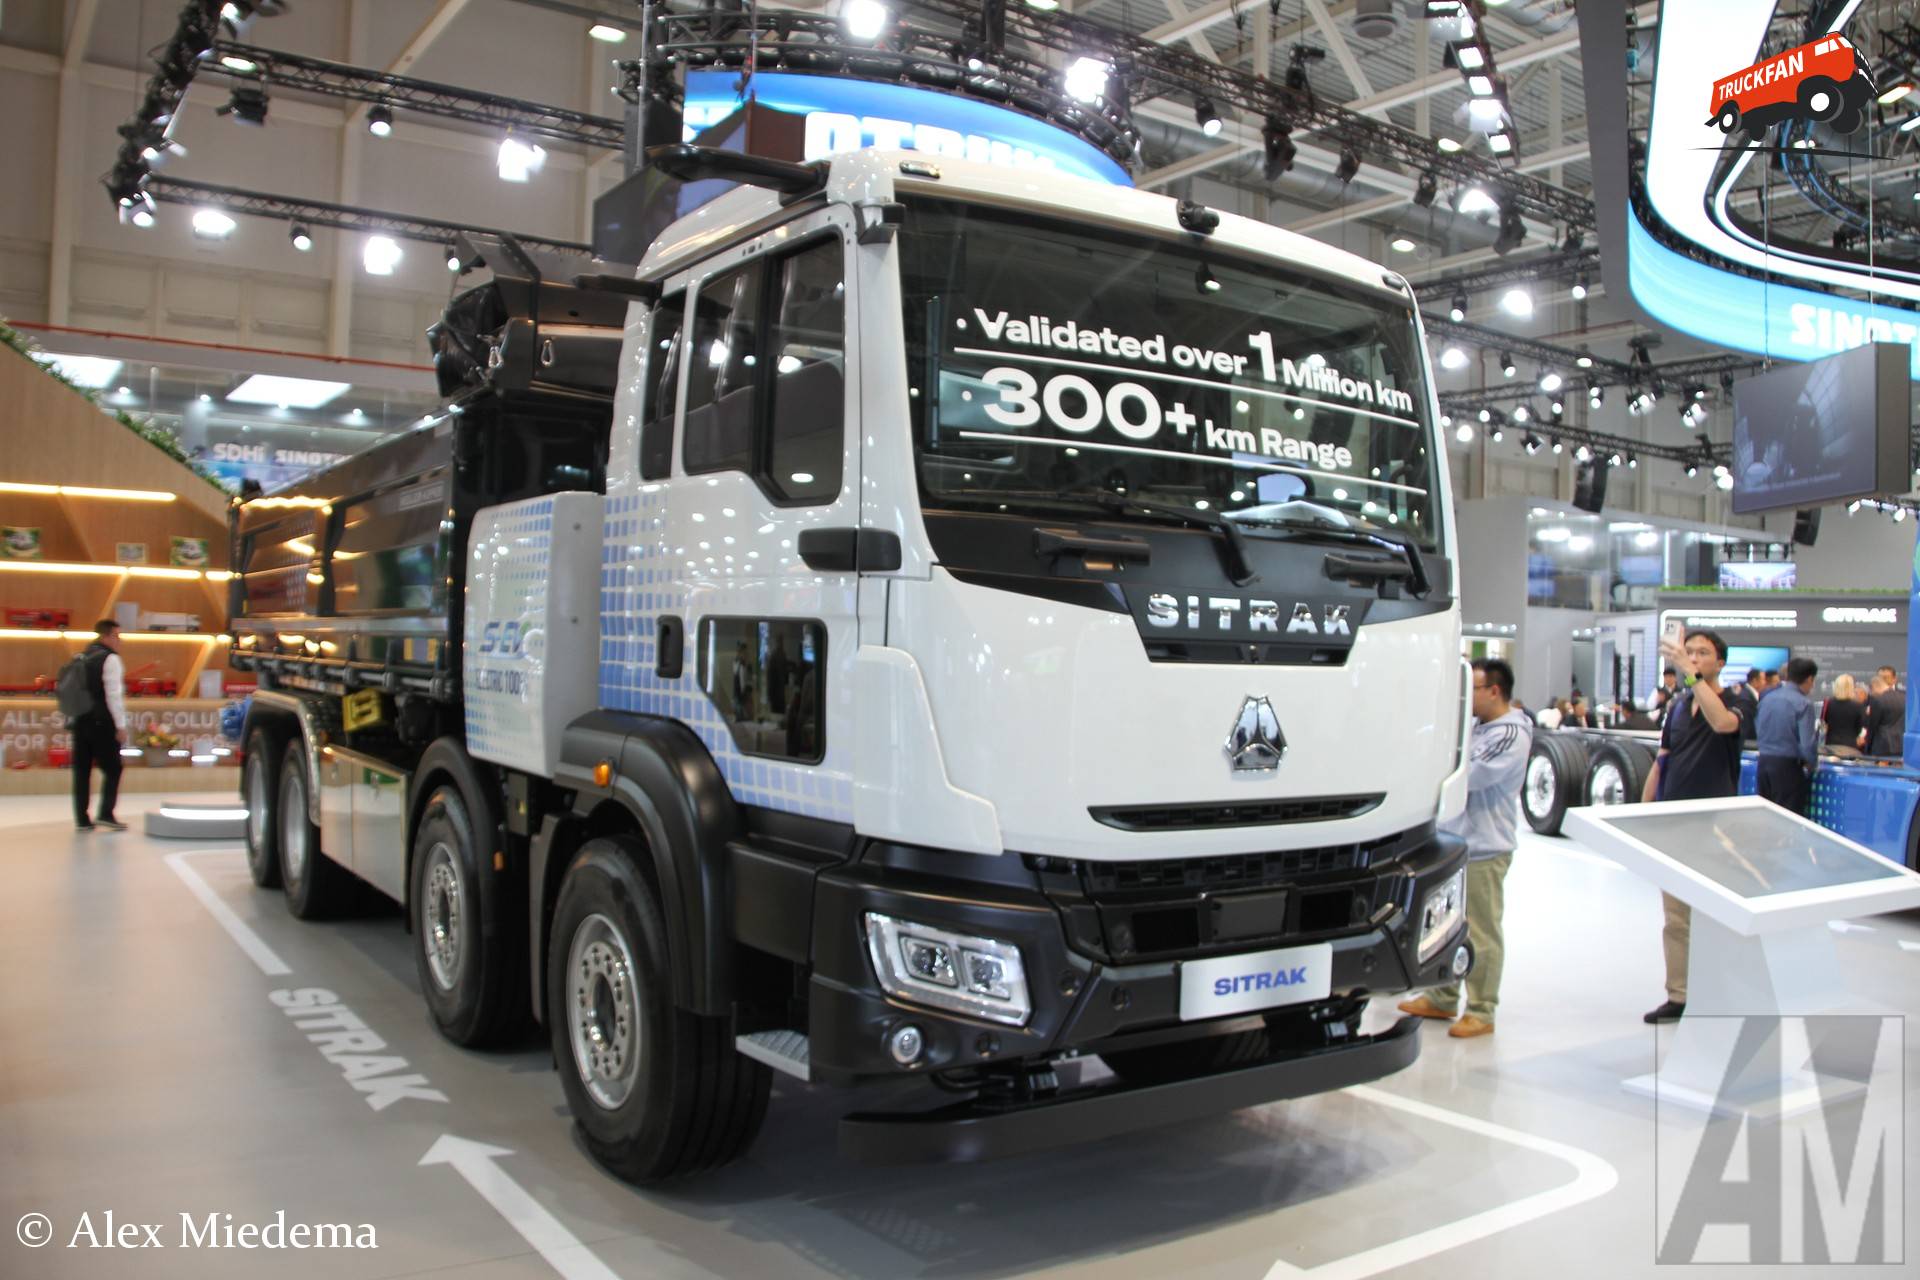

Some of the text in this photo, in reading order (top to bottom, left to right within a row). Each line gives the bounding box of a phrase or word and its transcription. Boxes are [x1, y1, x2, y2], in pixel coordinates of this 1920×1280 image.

[974, 307, 1414, 413] Validated over 1 Million km
[981, 366, 1353, 470] 300+ km Range
[1147, 593, 1351, 635] SITRAK
[1213, 966, 1307, 996] SITRAK
[268, 987, 449, 1112] SITRAK
